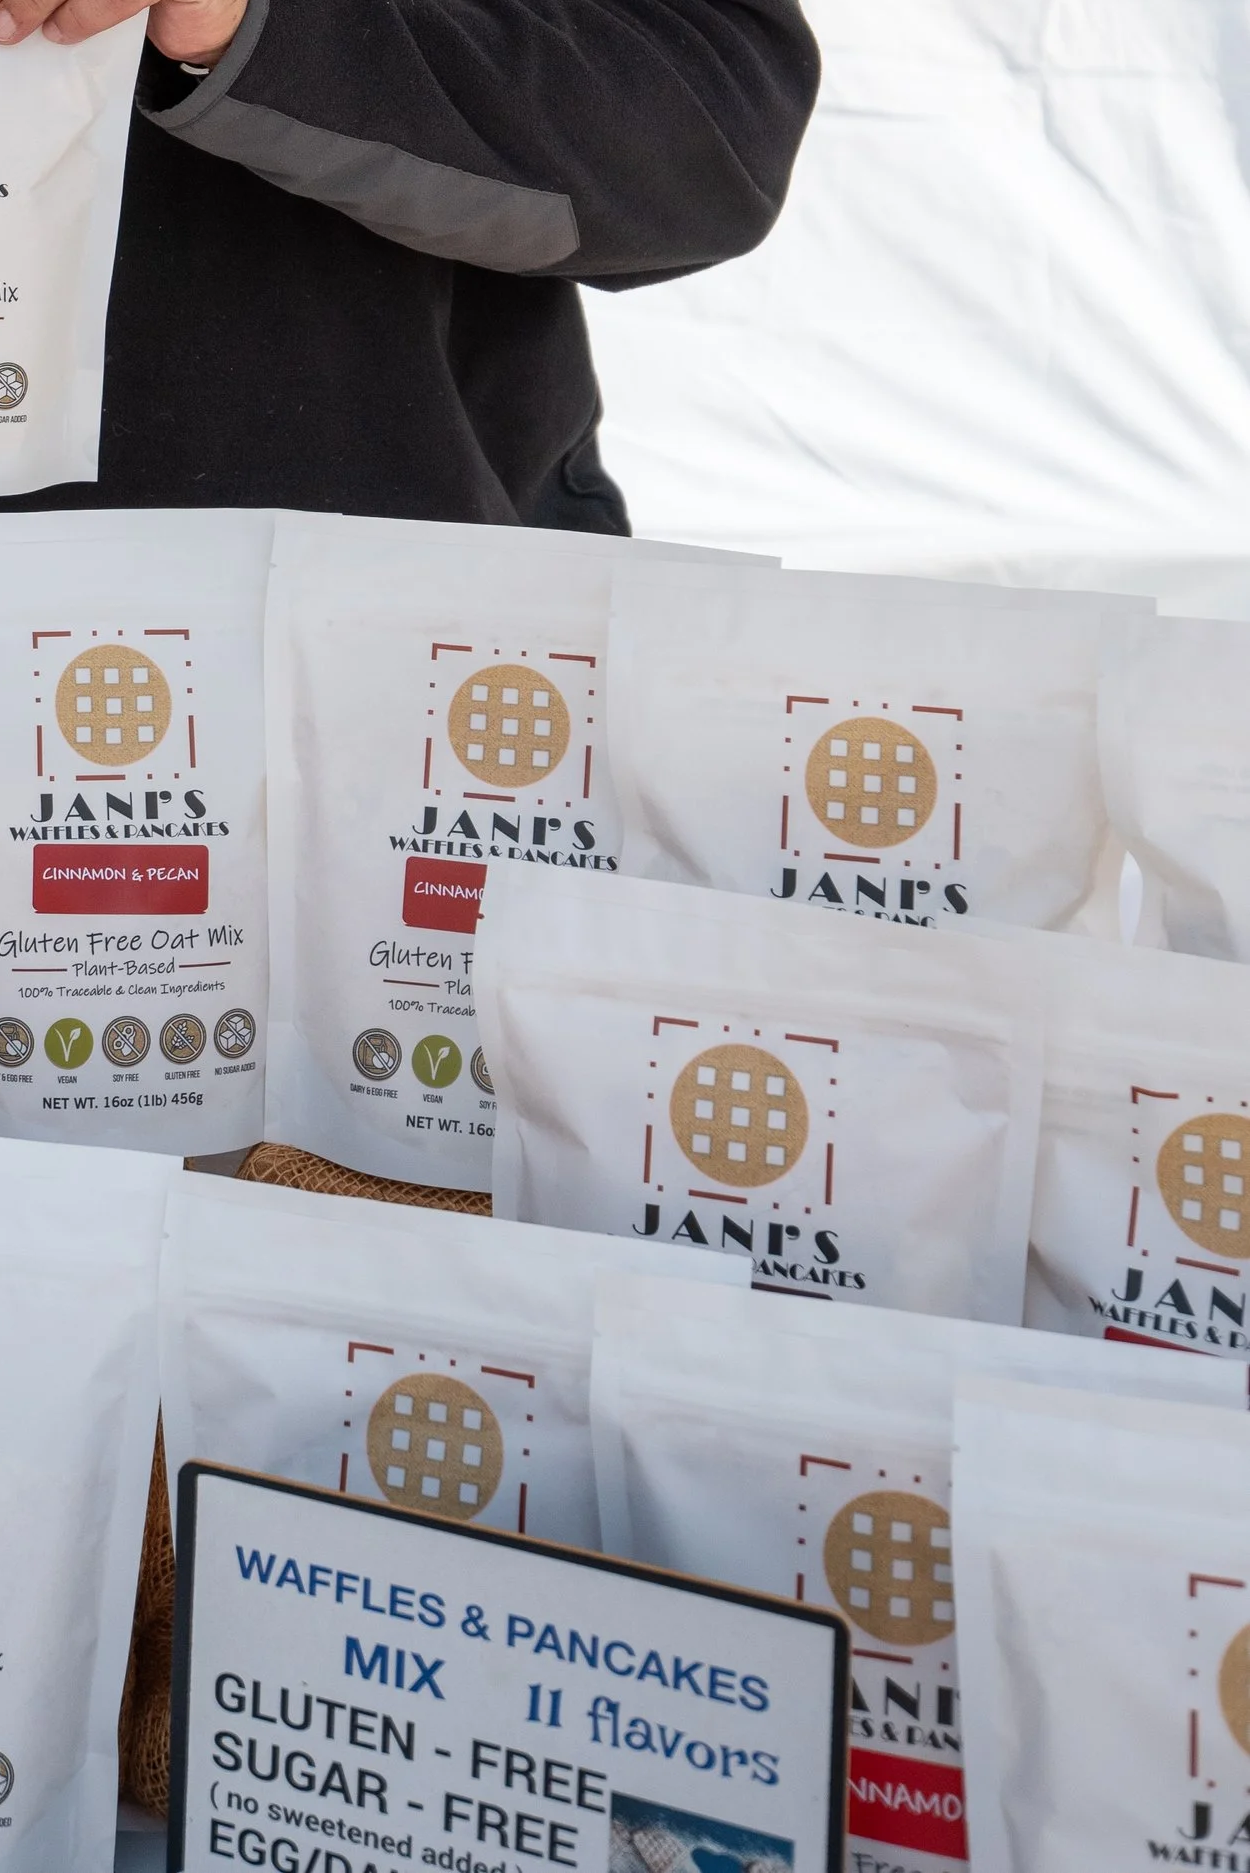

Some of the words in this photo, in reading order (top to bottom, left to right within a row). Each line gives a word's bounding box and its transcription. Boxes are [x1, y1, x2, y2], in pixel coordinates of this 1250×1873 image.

[9, 415, 27, 423] ADDED
[30, 789, 207, 823] JANI'S
[9, 824, 101, 842] WAFFLES
[105, 824, 119, 839] &
[124, 821, 230, 838] PANCAKES
[412, 806, 595, 851] JANI'S
[389, 835, 483, 859] WAFFLES
[488, 845, 503, 858] &
[508, 847, 618, 872] PANCAKES
[43, 867, 126, 881] CINNAMON
[131, 867, 144, 881] &
[146, 867, 199, 881] PECAN
[86, 932, 142, 956] Free
[151, 929, 200, 950] Oat
[208, 925, 244, 947] Mix
[369, 940, 452, 970] Gluten
[72, 957, 175, 977] Plant-Based
[18, 987, 53, 998] 100%
[56, 984, 112, 997] Traceable
[115, 985, 125, 995] &
[128, 983, 157, 995] Clean
[160, 980, 226, 997] Ingredients
[388, 999, 424, 1012] 100%
[6, 1074, 17, 1082] EGG
[18, 1074, 33, 1083] FREE
[112, 1074, 124, 1083] SOY
[125, 1073, 139, 1082] FREE
[165, 1071, 185, 1080] GLUTEN
[185, 1070, 200, 1079] FREE
[214, 1067, 222, 1075] NO
[222, 1065, 240, 1075] SUGAR
[240, 1062, 256, 1072] ADDED
[57, 1076, 77, 1084] VEGAN
[42, 1097, 70, 1109] NET
[74, 1097, 98, 1109] WT.
[103, 1096, 134, 1108] 16oz
[137, 1094, 167, 1108] (1lb)
[171, 1092, 203, 1105] 456g
[350, 1083, 366, 1094] DAIRY
[371, 1087, 383, 1097] EGG
[384, 1089, 398, 1099] FREE
[423, 1094, 443, 1104] VEGAN
[479, 1100, 491, 1110] SOY
[406, 1115, 433, 1129] NET
[438, 1118, 463, 1133] WT.
[468, 1122, 495, 1137] 16o
[1088, 1295, 1198, 1339] WAFFLES
[1204, 1325, 1222, 1346] &
[234, 1543, 447, 1630] WAFFLES
[462, 1604, 491, 1641] &
[507, 1613, 770, 1714] PANCAKES
[344, 1634, 446, 1700] MIX
[587, 1695, 779, 1787] flavors
[214, 1671, 415, 1762] GLUTEN
[470, 1739, 609, 1815] FREE
[211, 1730, 390, 1815] SUGAR
[443, 1792, 580, 1868] FREE
[227, 1791, 259, 1815] no
[268, 1802, 413, 1859] sweetened
